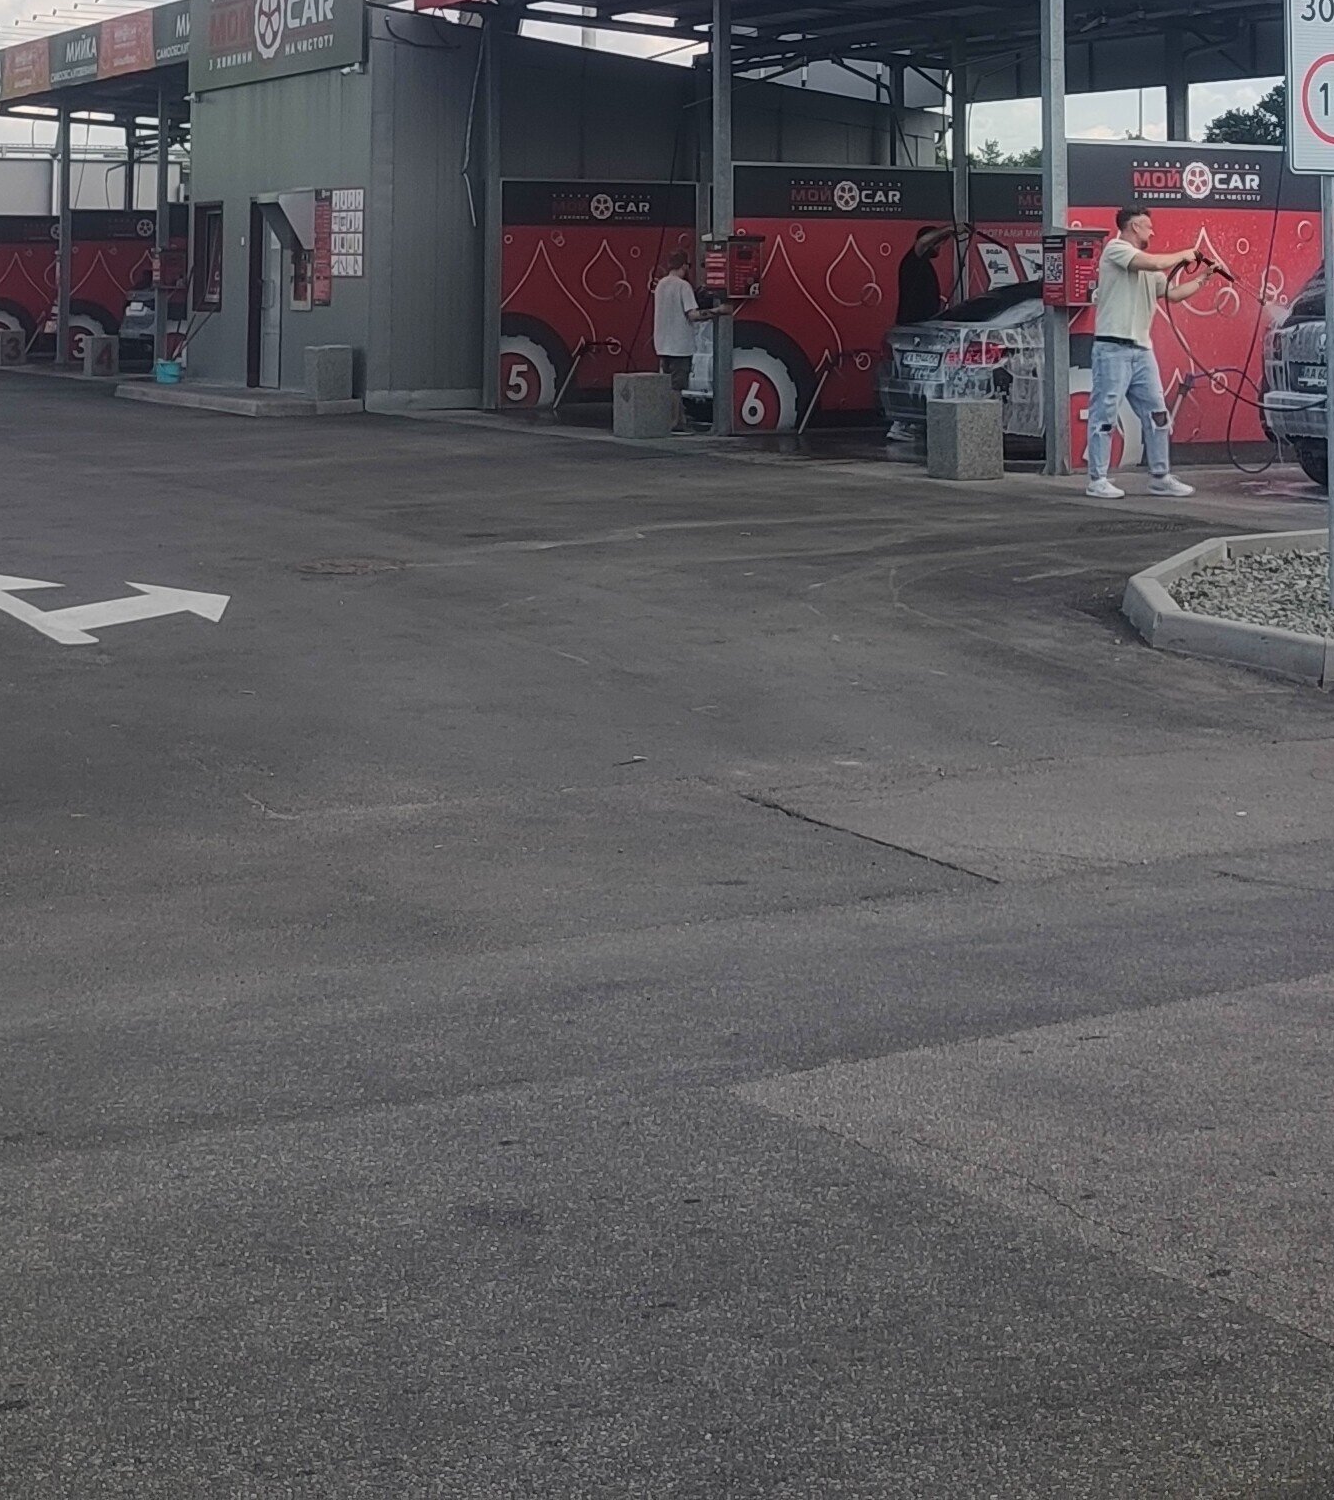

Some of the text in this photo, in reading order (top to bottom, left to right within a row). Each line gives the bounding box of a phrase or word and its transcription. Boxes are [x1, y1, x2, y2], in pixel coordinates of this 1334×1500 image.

[66, 34, 97, 63] МИЙКА
[217, 51, 253, 69] ХВИЛИНИ
[285, 43, 296, 56] НА
[298, 34, 334, 53] ЧИСТОТУ
[1133, 169, 1260, 190] МОЙ CAR
[615, 201, 650, 213] CAR
[861, 190, 901, 203] CAR
[506, 364, 528, 401] 5
[741, 381, 765, 425] 6
